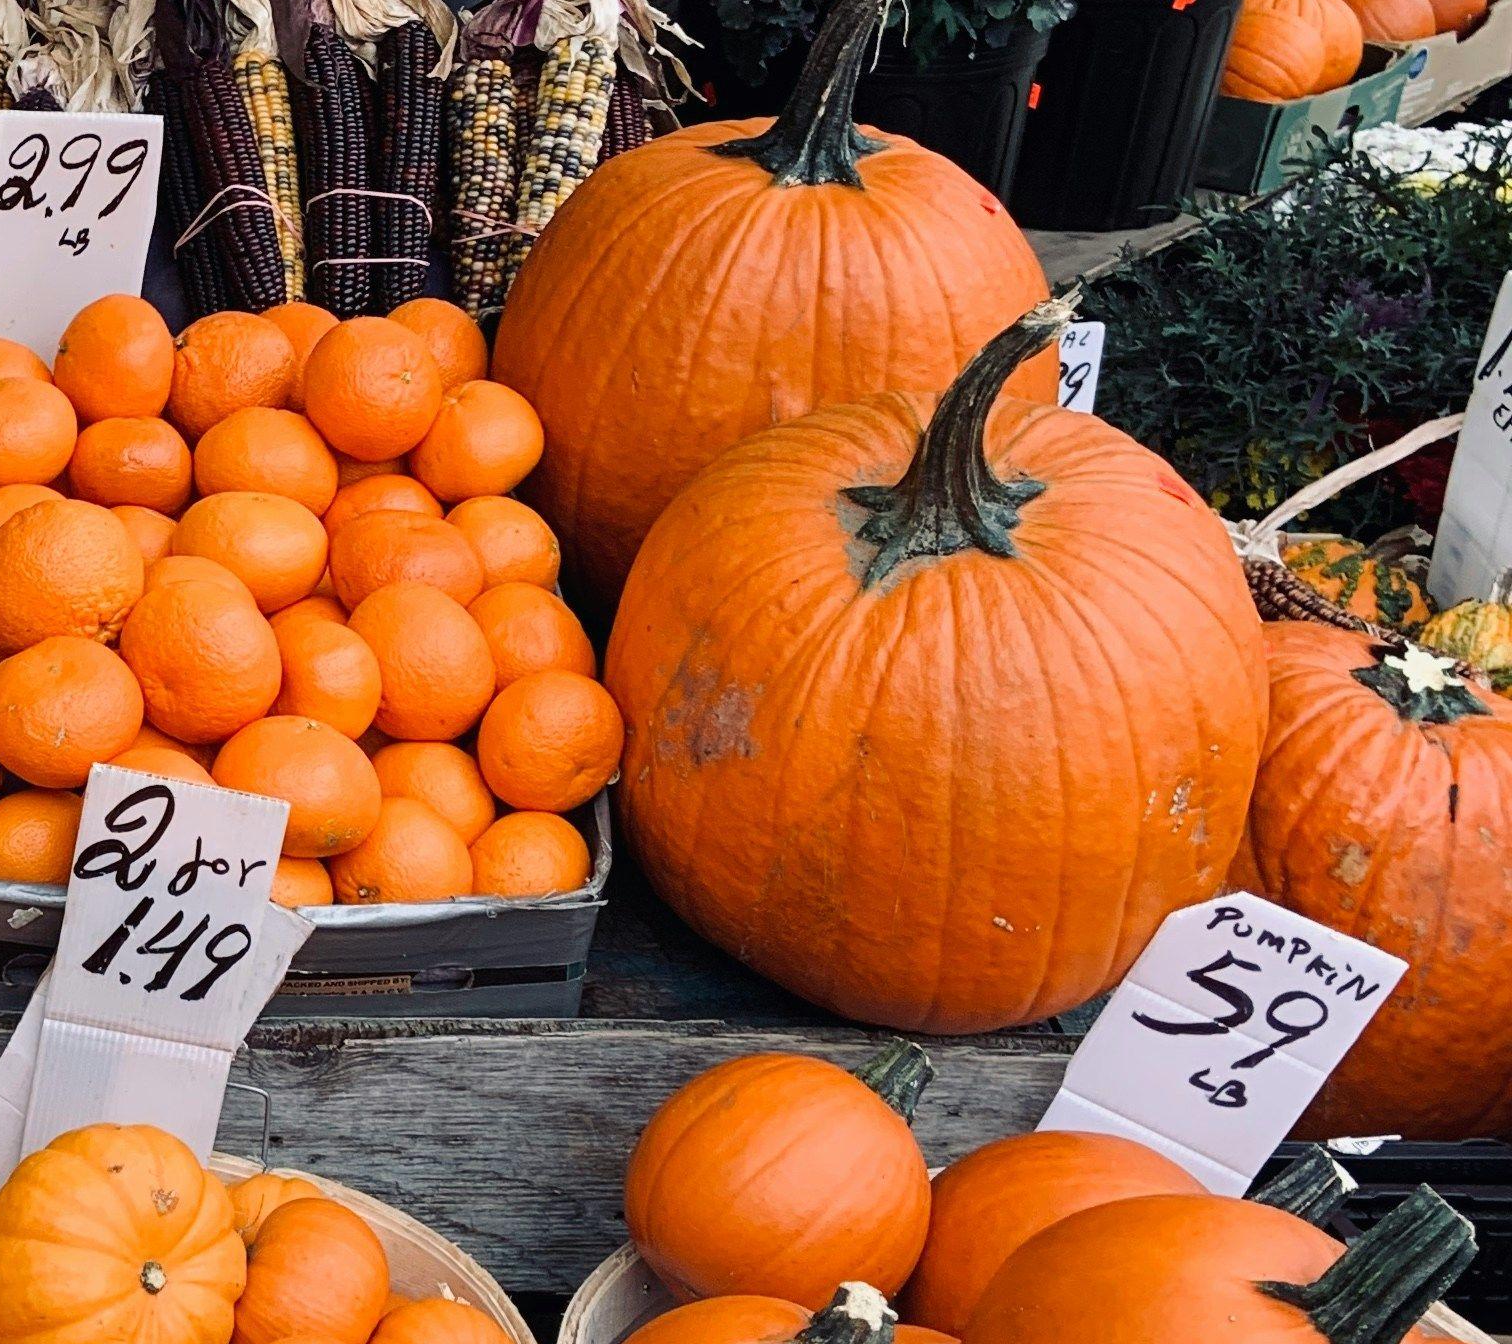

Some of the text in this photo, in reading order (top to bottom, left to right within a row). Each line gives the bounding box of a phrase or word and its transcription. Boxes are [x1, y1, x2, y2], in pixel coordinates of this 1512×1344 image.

[73, 783, 268, 897] 2 for
[80, 895, 253, 1002] 1.49
[323, 980, 345, 988] AND
[1130, 948, 1330, 1071] 59
[1187, 1067, 1249, 1109] LB
